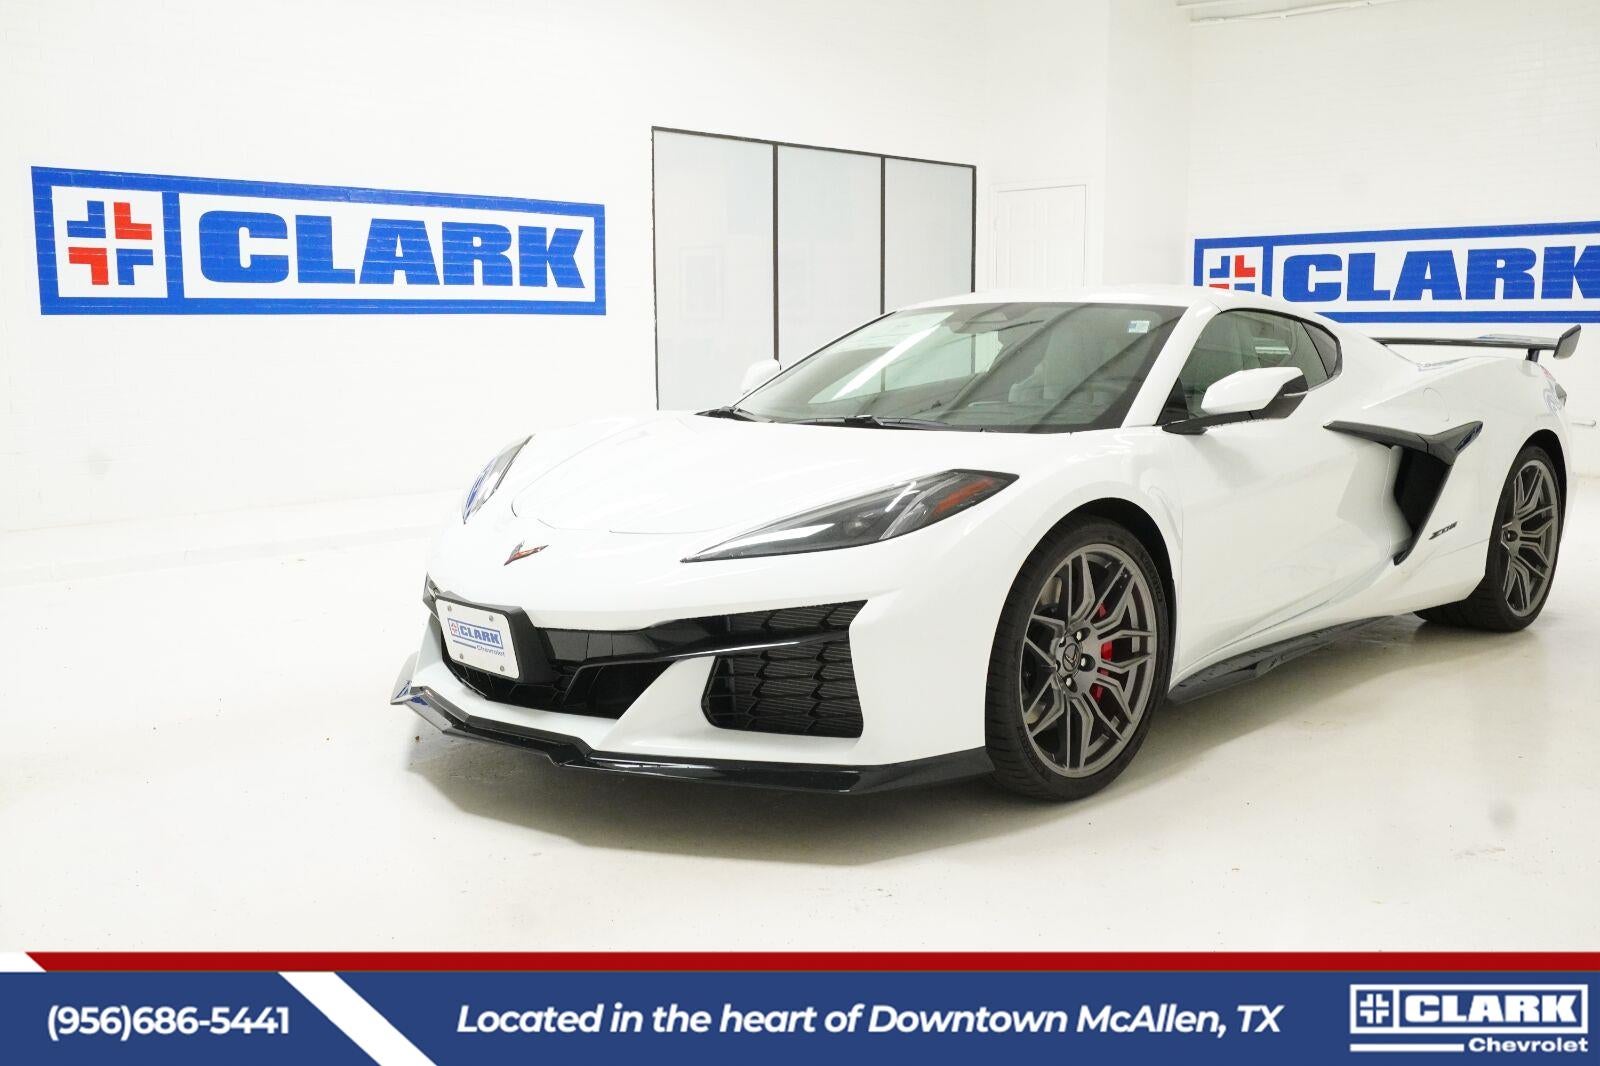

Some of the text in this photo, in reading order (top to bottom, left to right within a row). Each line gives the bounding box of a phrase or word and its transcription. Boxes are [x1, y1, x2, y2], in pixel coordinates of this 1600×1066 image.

[199, 211, 585, 288] CLARK
[1283, 245, 1600, 302] CLARK
[460, 625, 500, 645] CLARK
